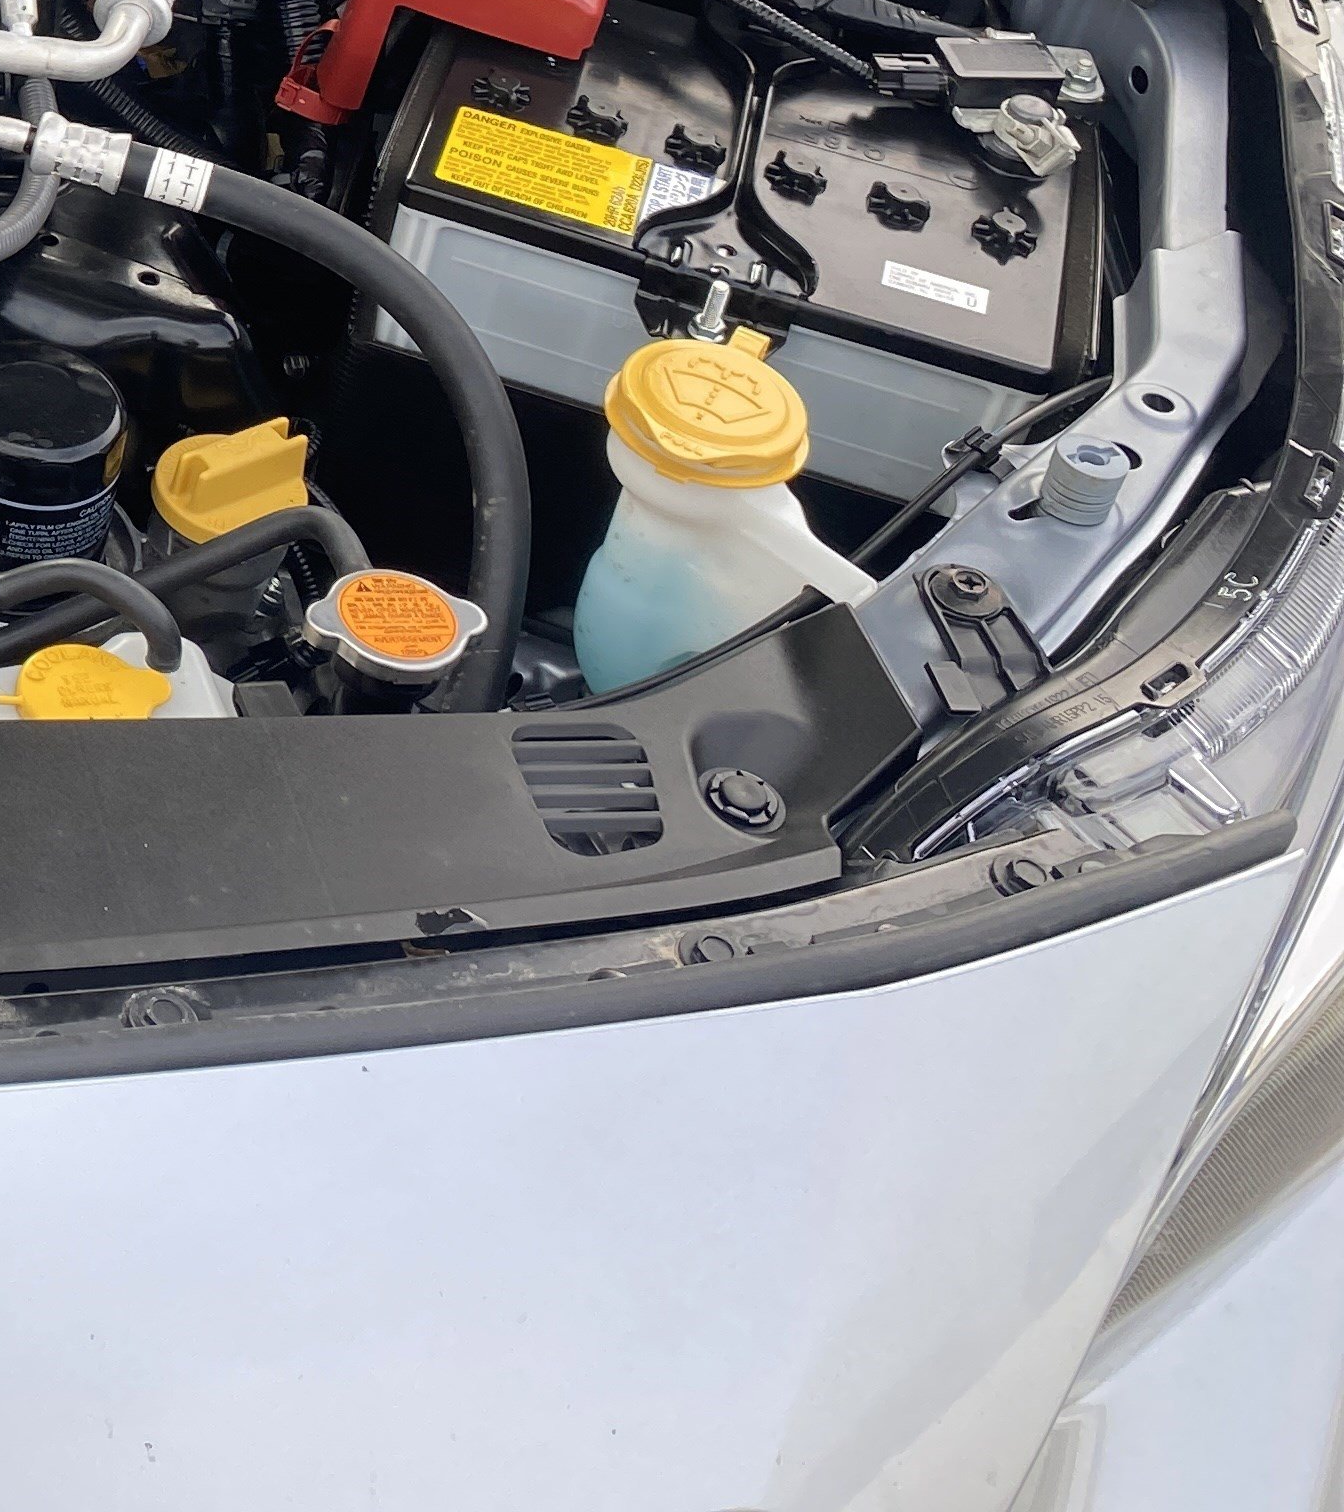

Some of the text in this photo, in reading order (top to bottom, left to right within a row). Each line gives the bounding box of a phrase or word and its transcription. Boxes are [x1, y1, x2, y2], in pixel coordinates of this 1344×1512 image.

[462, 110, 517, 131] DANGER
[448, 146, 599, 196] POISON CAUSES SEVERE BURNS
[462, 140, 600, 185] KEEP VENT CAPS TIGHT AND LEVEL
[652, 166, 673, 192] START
[450, 172, 587, 219] KEEP OUT OF REACH OF CHILDREN
